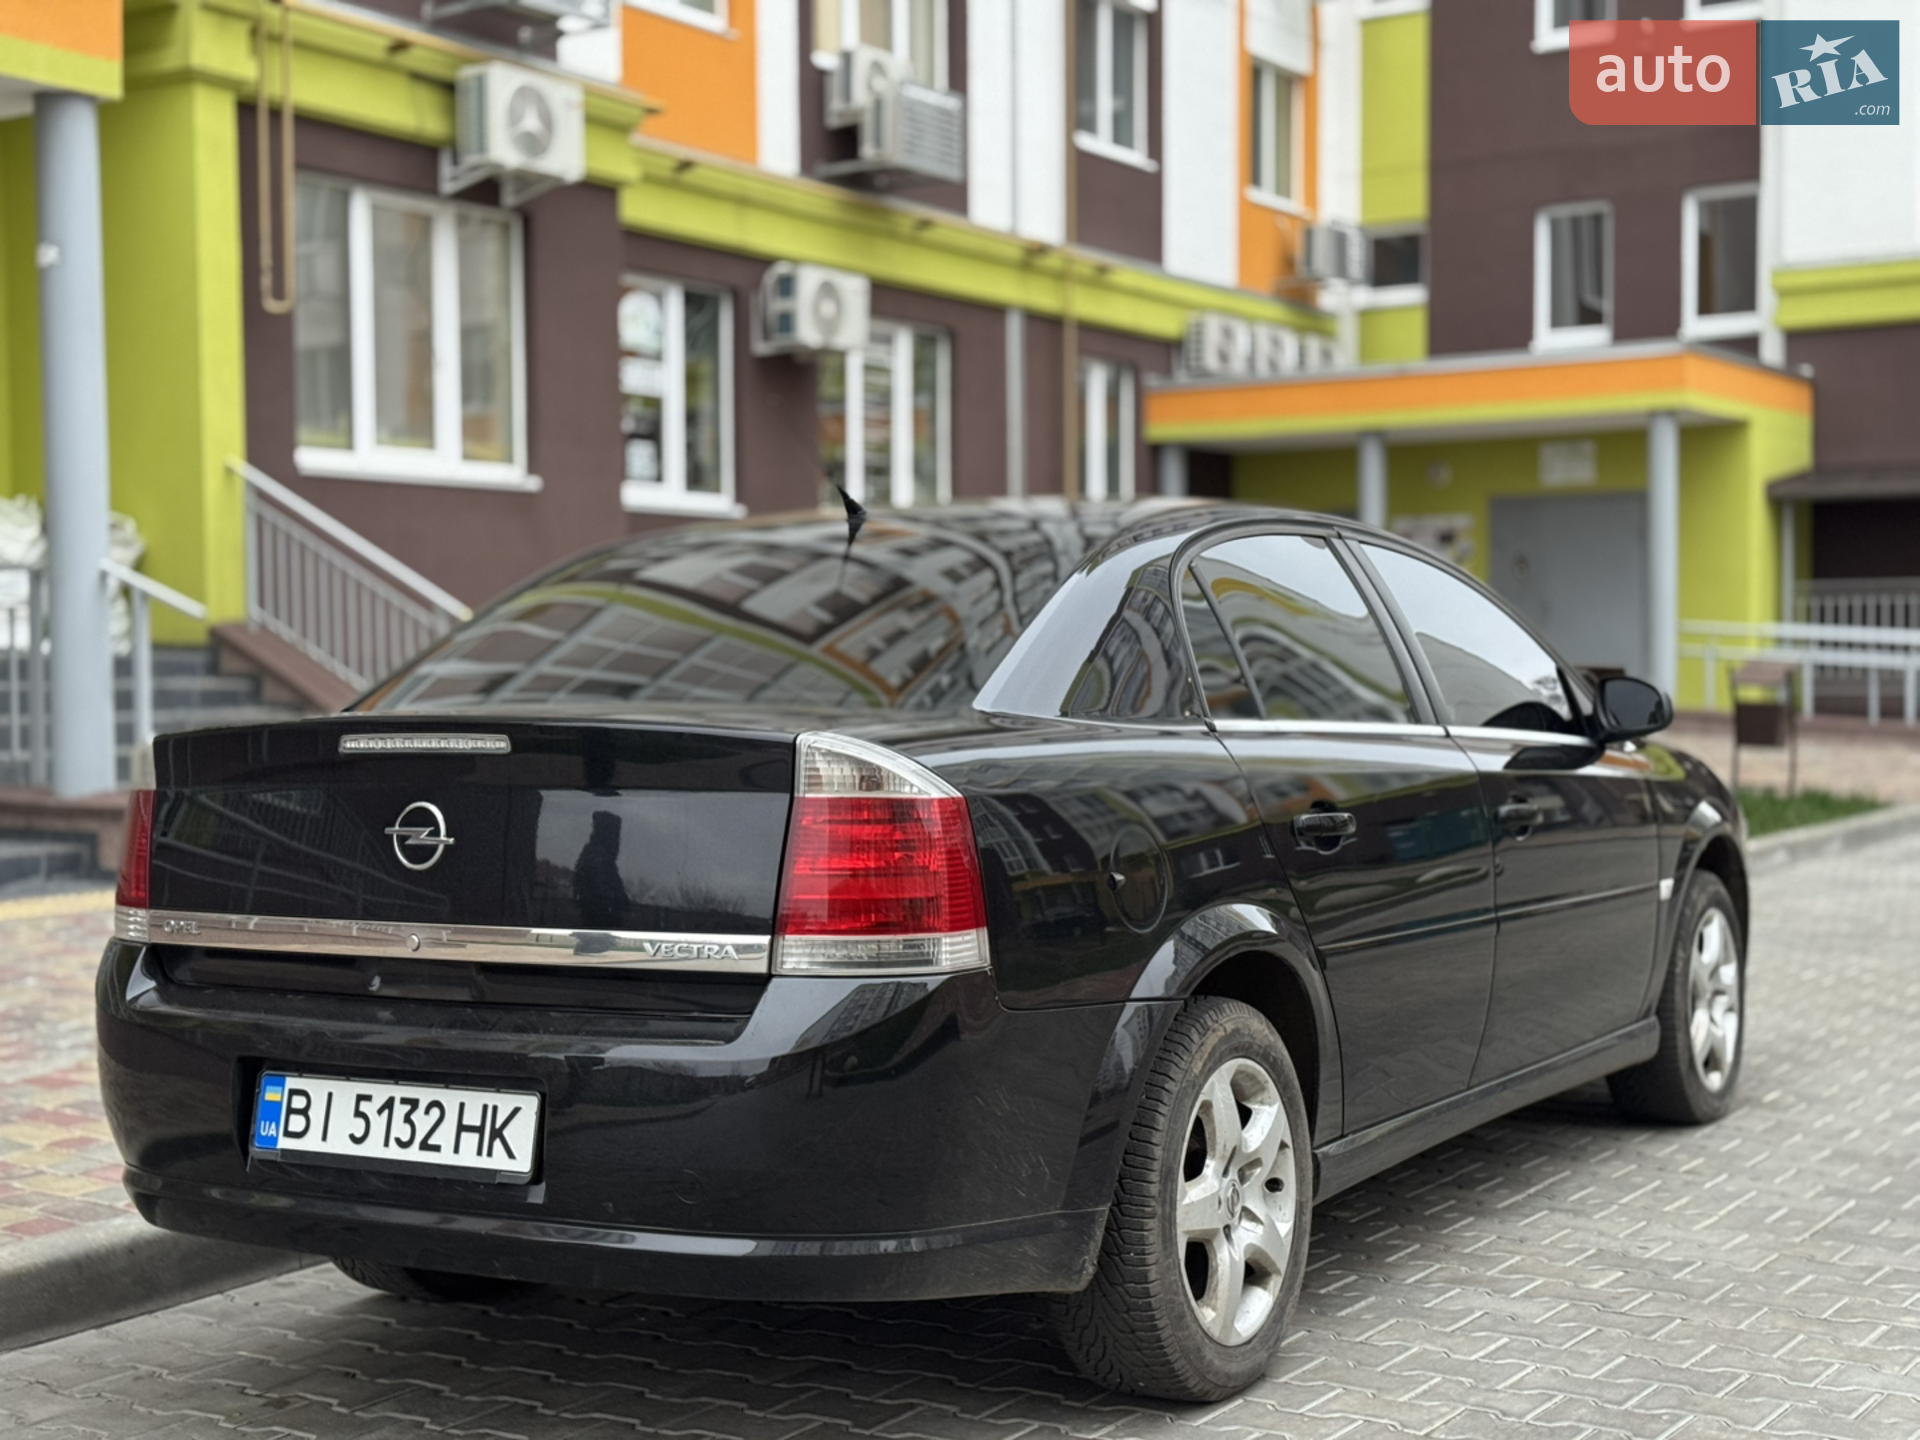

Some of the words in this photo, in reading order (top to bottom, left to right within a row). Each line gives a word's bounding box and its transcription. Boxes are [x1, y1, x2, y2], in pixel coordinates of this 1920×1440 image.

[162, 919, 201, 935] OPEL
[643, 942, 739, 960] VECTRA
[260, 1121, 277, 1137] UA
[348, 1093, 446, 1153] 5132
[453, 1101, 522, 1160] HK
